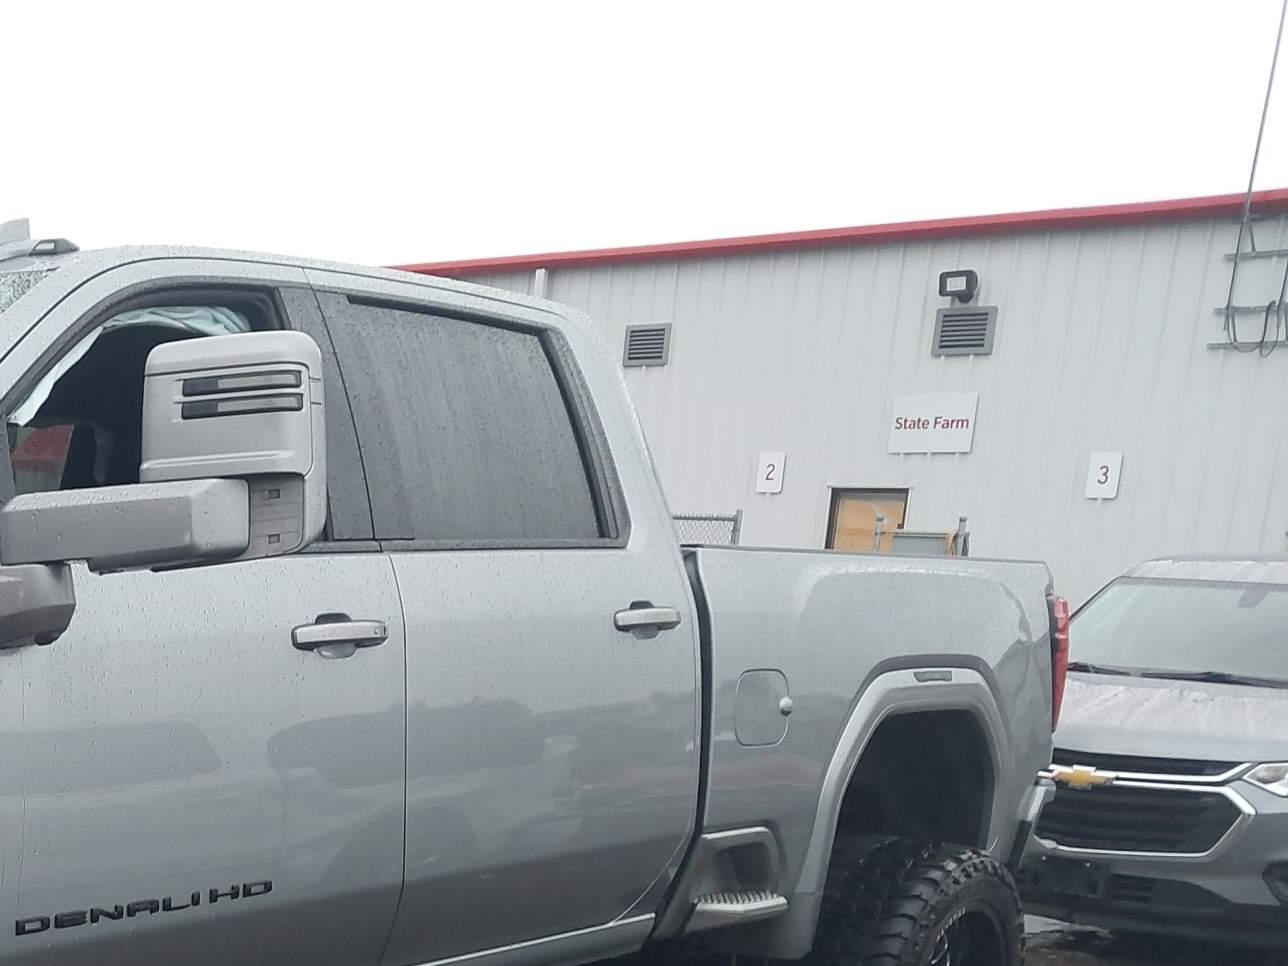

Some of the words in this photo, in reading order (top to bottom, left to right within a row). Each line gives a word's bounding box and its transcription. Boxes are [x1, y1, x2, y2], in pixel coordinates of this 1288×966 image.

[894, 416, 930, 430] State
[933, 415, 969, 430] Farm
[765, 463, 776, 481] 2
[1097, 465, 1109, 485] 3
[15, 890, 200, 936] DENALI
[208, 879, 273, 904] HD
